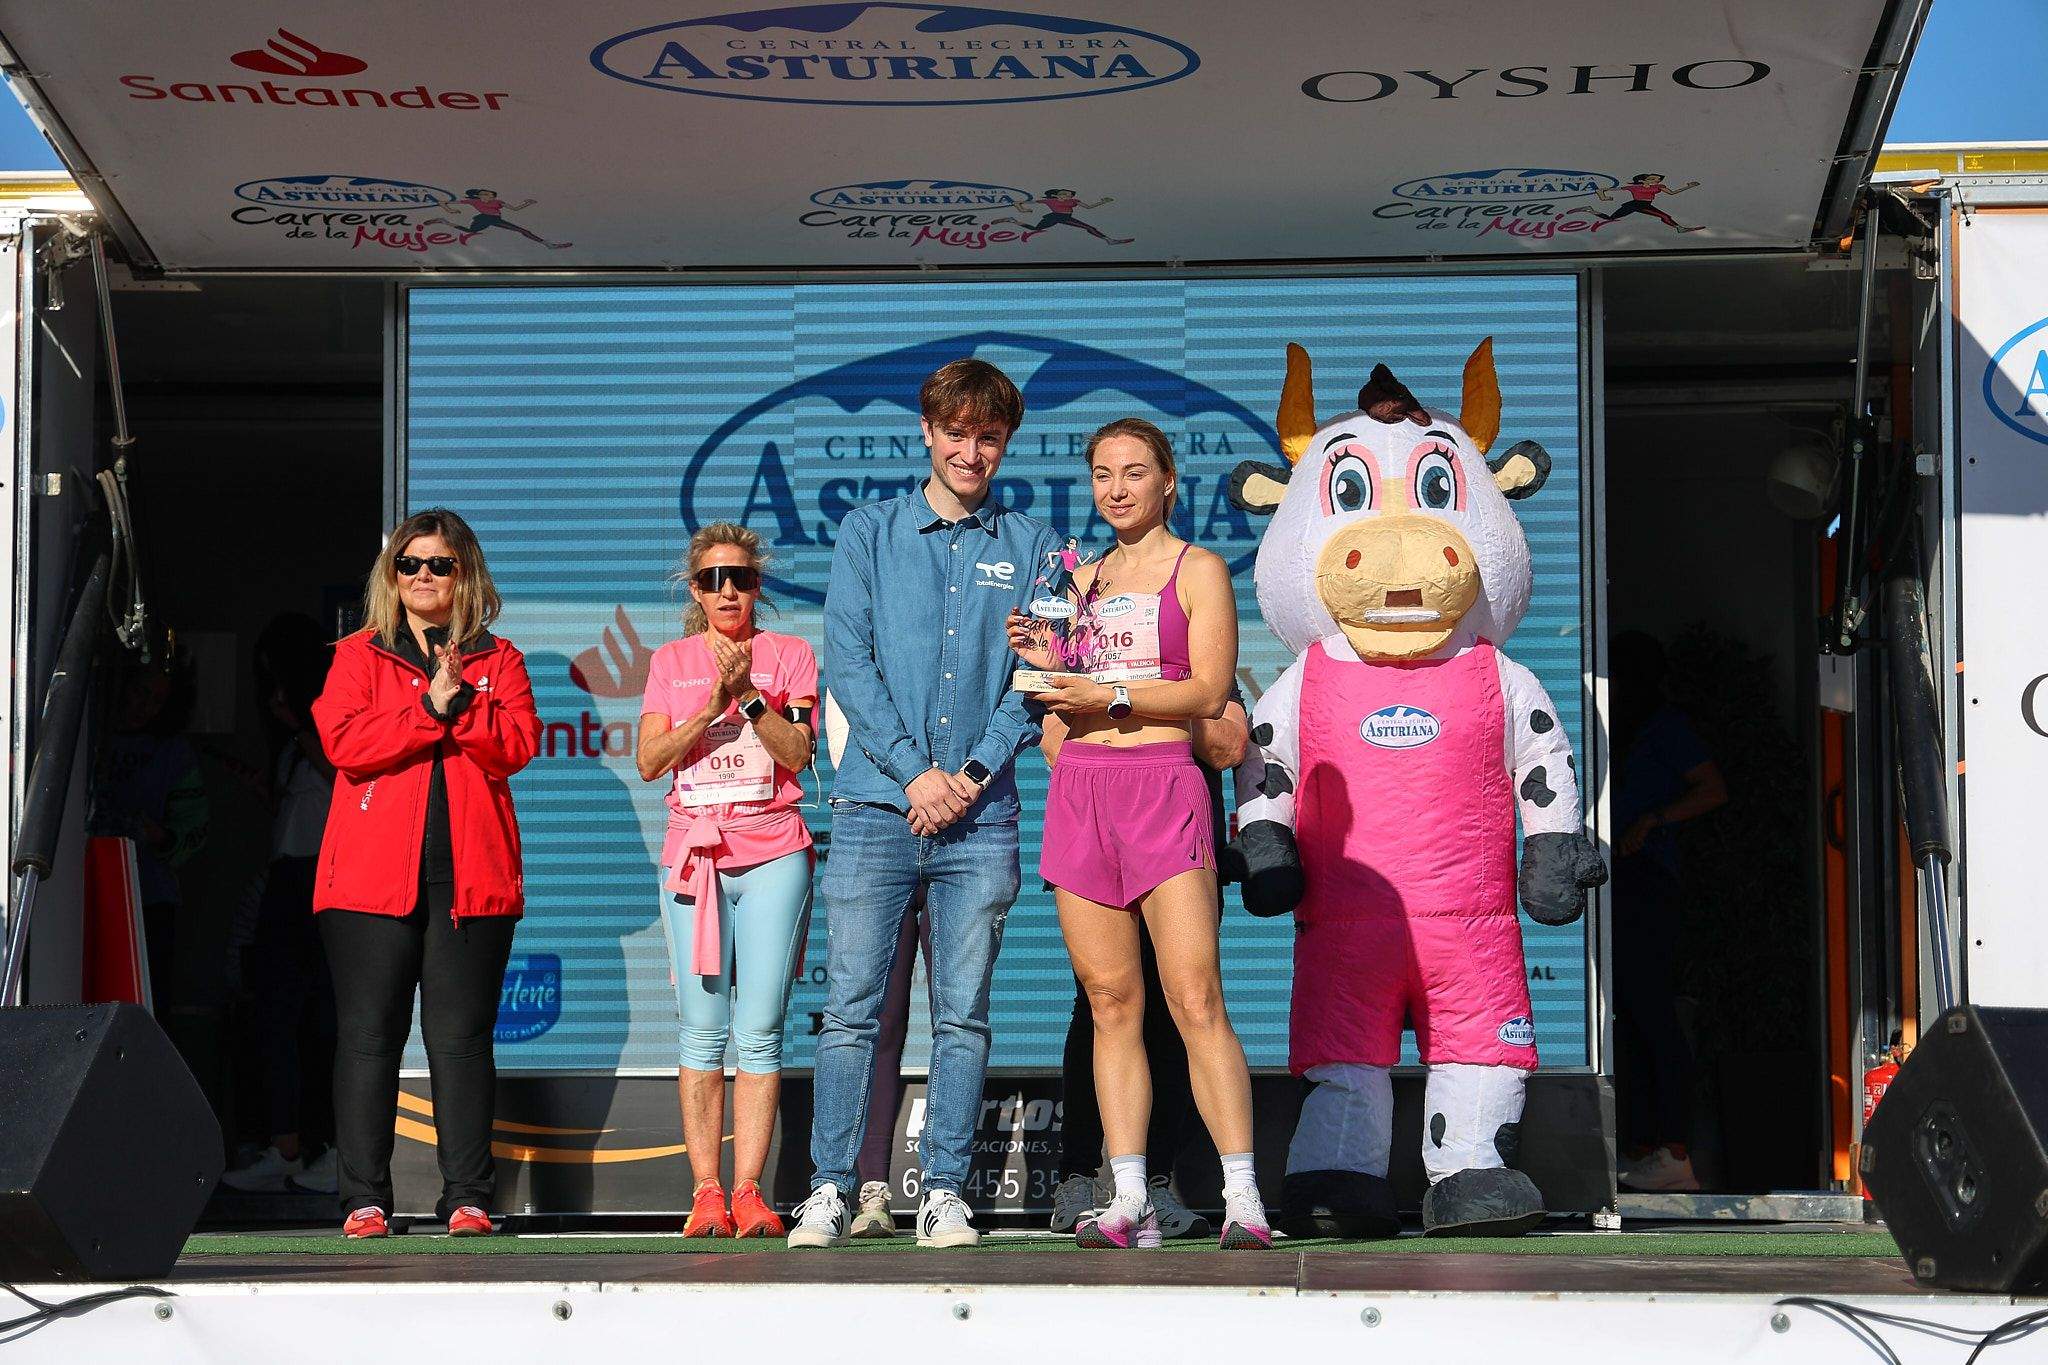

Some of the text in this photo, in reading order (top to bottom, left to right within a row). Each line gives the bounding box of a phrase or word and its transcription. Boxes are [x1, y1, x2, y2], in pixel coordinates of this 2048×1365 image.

[726, 38, 1132, 50] CENTRAL LECHERA
[642, 41, 1156, 81] ASTURIANA
[1300, 59, 1771, 103] OYSHO
[119, 74, 509, 111] Santander
[256, 186, 439, 204] ASTURIANA
[1411, 180, 1599, 196] ASTURIANA
[830, 191, 1016, 205] ASTURIANA
[231, 207, 411, 226] Carrera
[799, 210, 979, 227] Carrera
[1372, 202, 1555, 219] Carrera
[1416, 213, 1622, 239] de la Mujer
[285, 224, 482, 252] de la Mujer
[847, 224, 1047, 249] de la Mujer
[1105, 652, 1121, 661] 1057
[1366, 721, 1435, 738] ASTURIANA
[710, 753, 745, 770] 016
[718, 771, 736, 780] 1990
